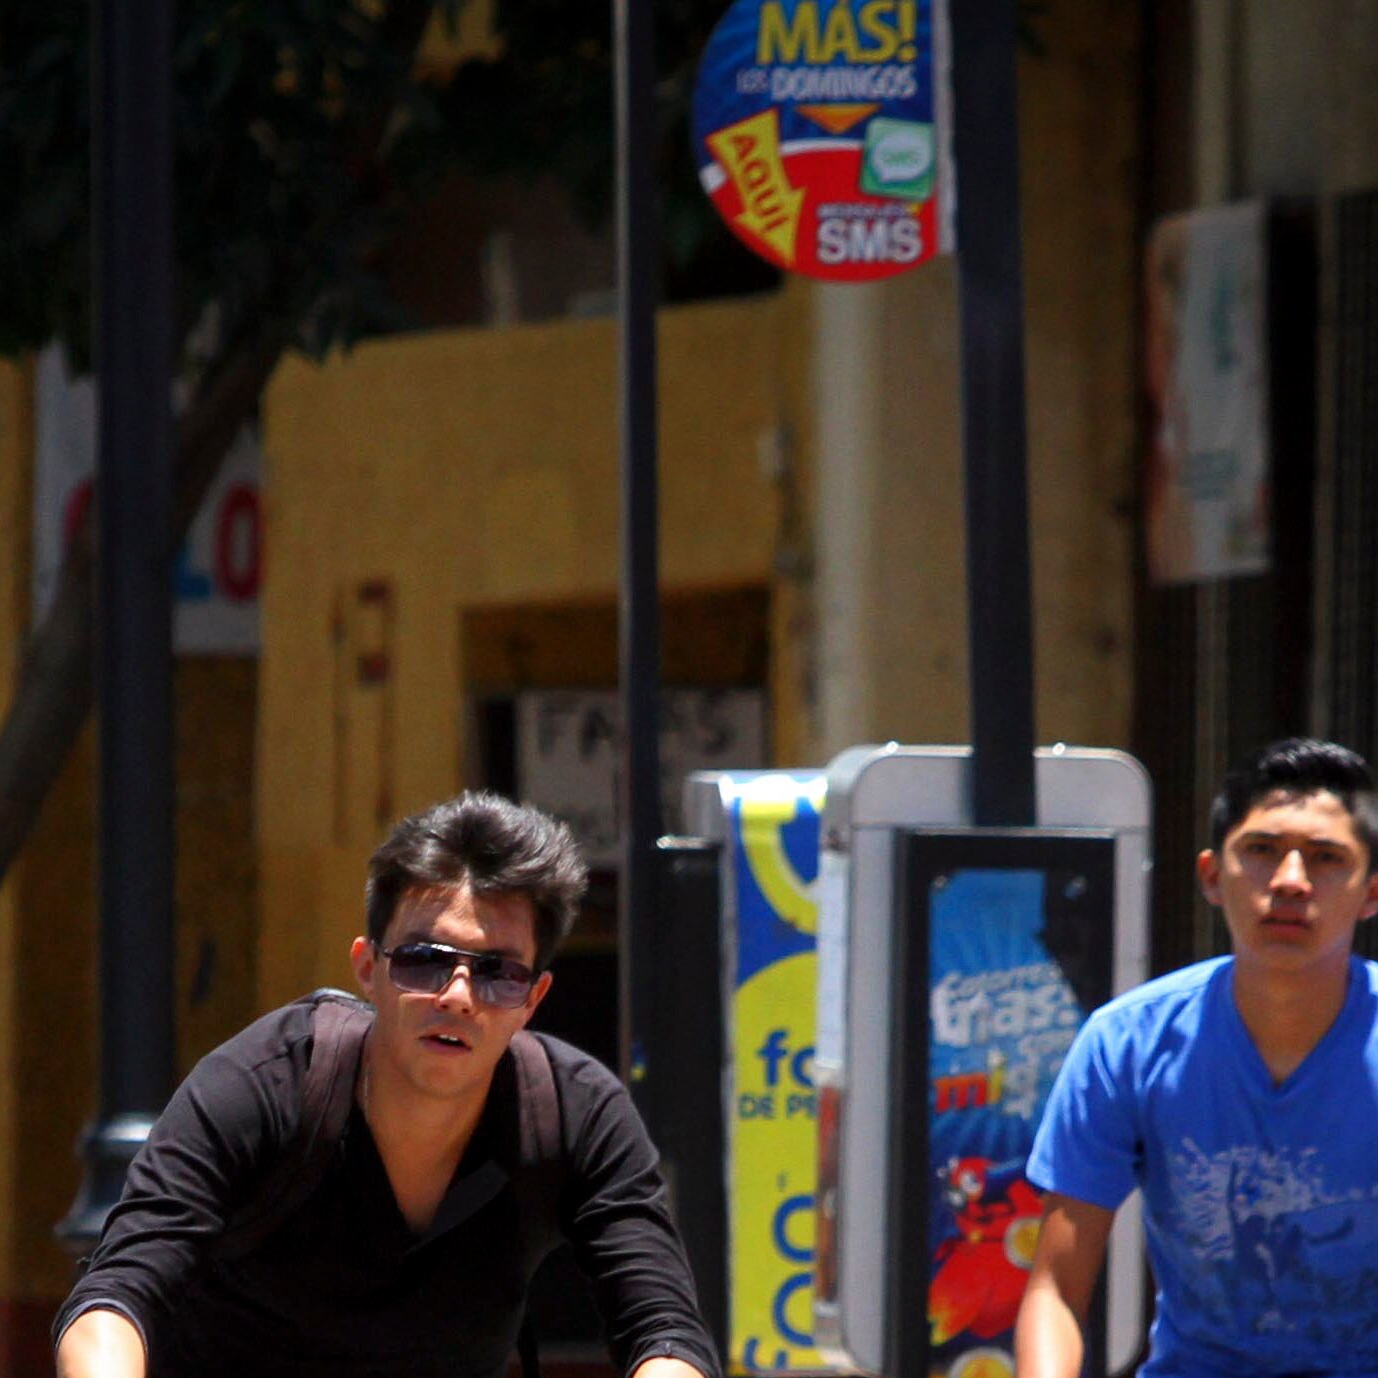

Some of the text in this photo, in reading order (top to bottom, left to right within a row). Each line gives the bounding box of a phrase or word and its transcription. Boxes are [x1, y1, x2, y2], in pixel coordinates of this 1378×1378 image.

[736, 66, 918, 100] LOS DOMINGOS
[815, 218, 925, 264] SMS
